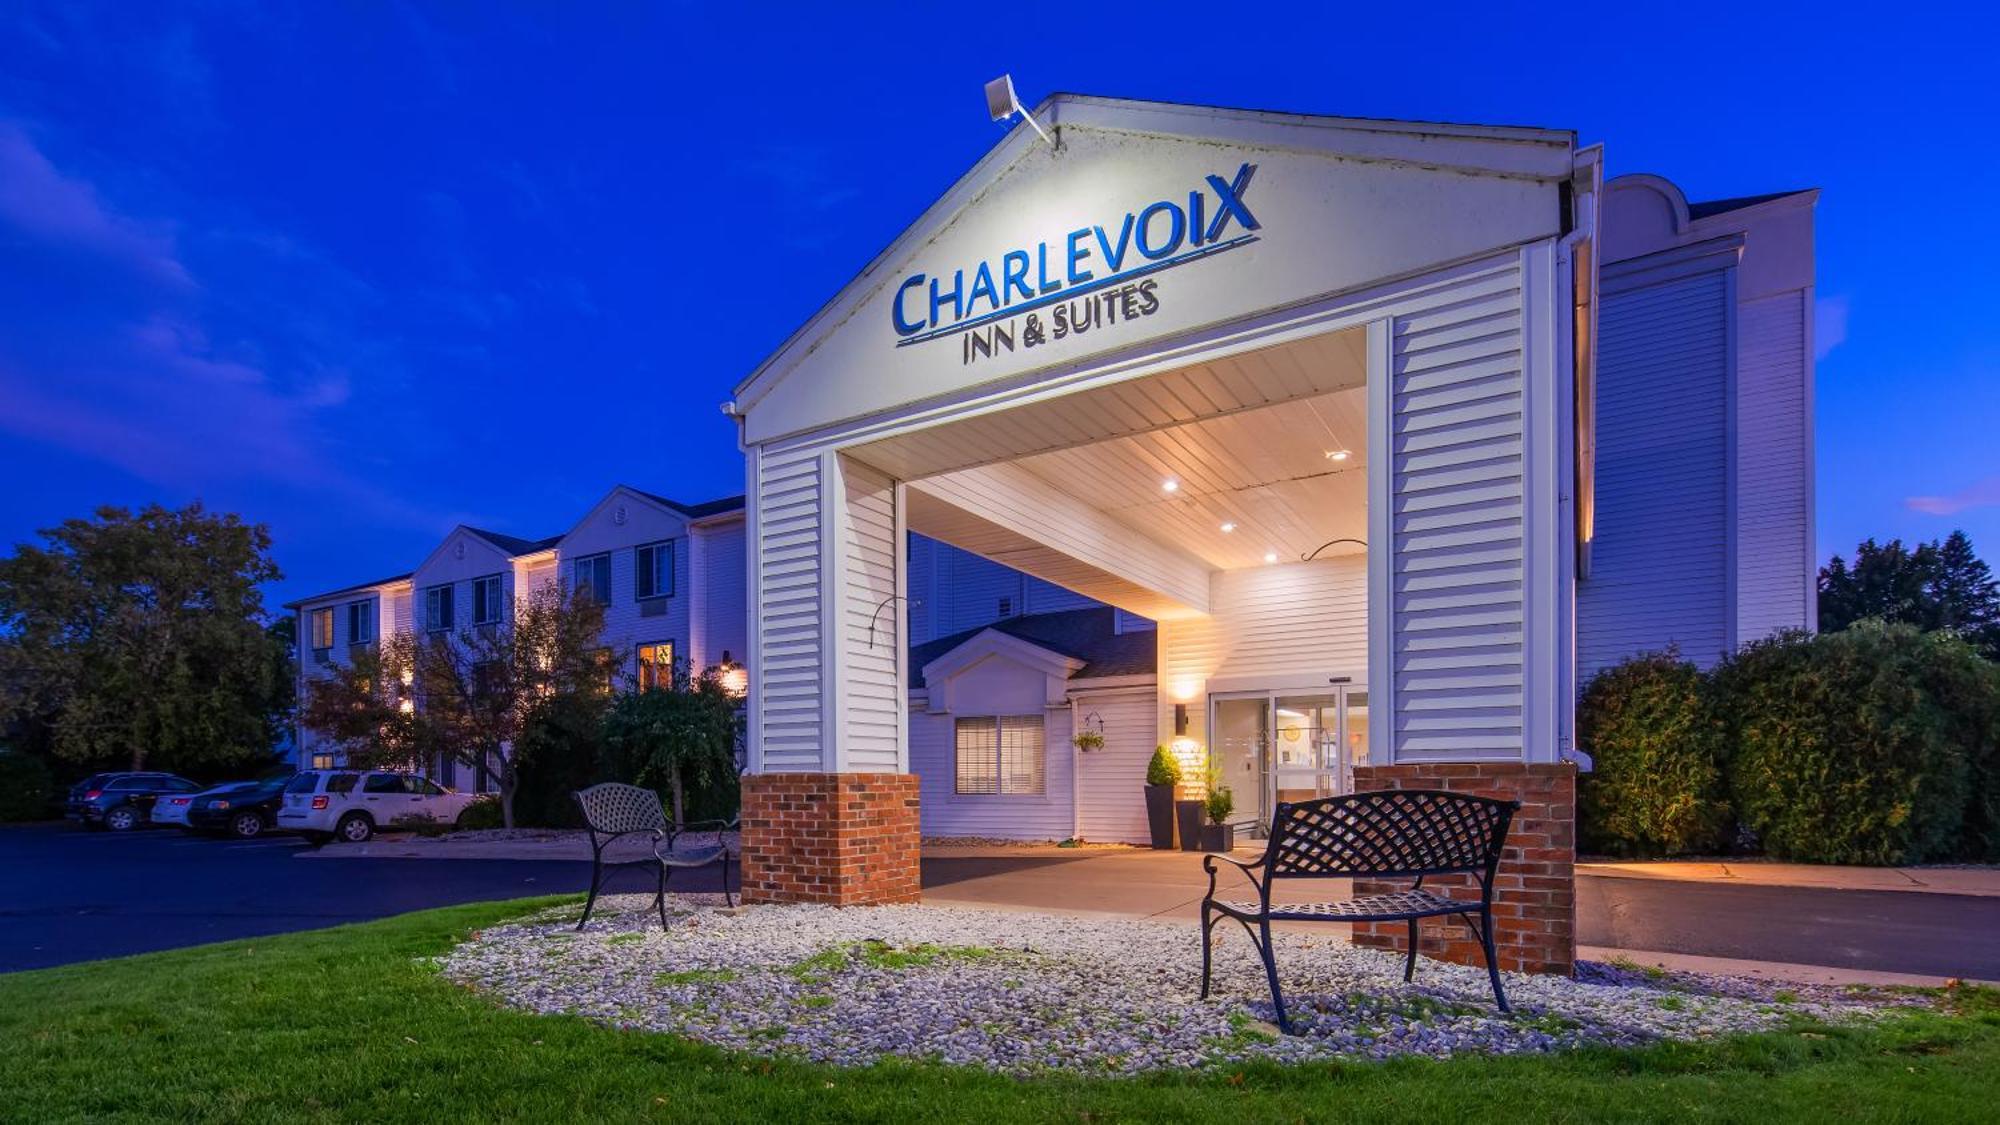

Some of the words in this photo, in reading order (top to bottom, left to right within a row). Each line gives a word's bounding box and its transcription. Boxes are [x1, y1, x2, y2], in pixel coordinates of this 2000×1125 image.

[892, 162, 1261, 337] CHARLEVOIX
[963, 324, 1015, 365] INN
[1023, 313, 1046, 348] &
[1052, 278, 1159, 339] SUITES
